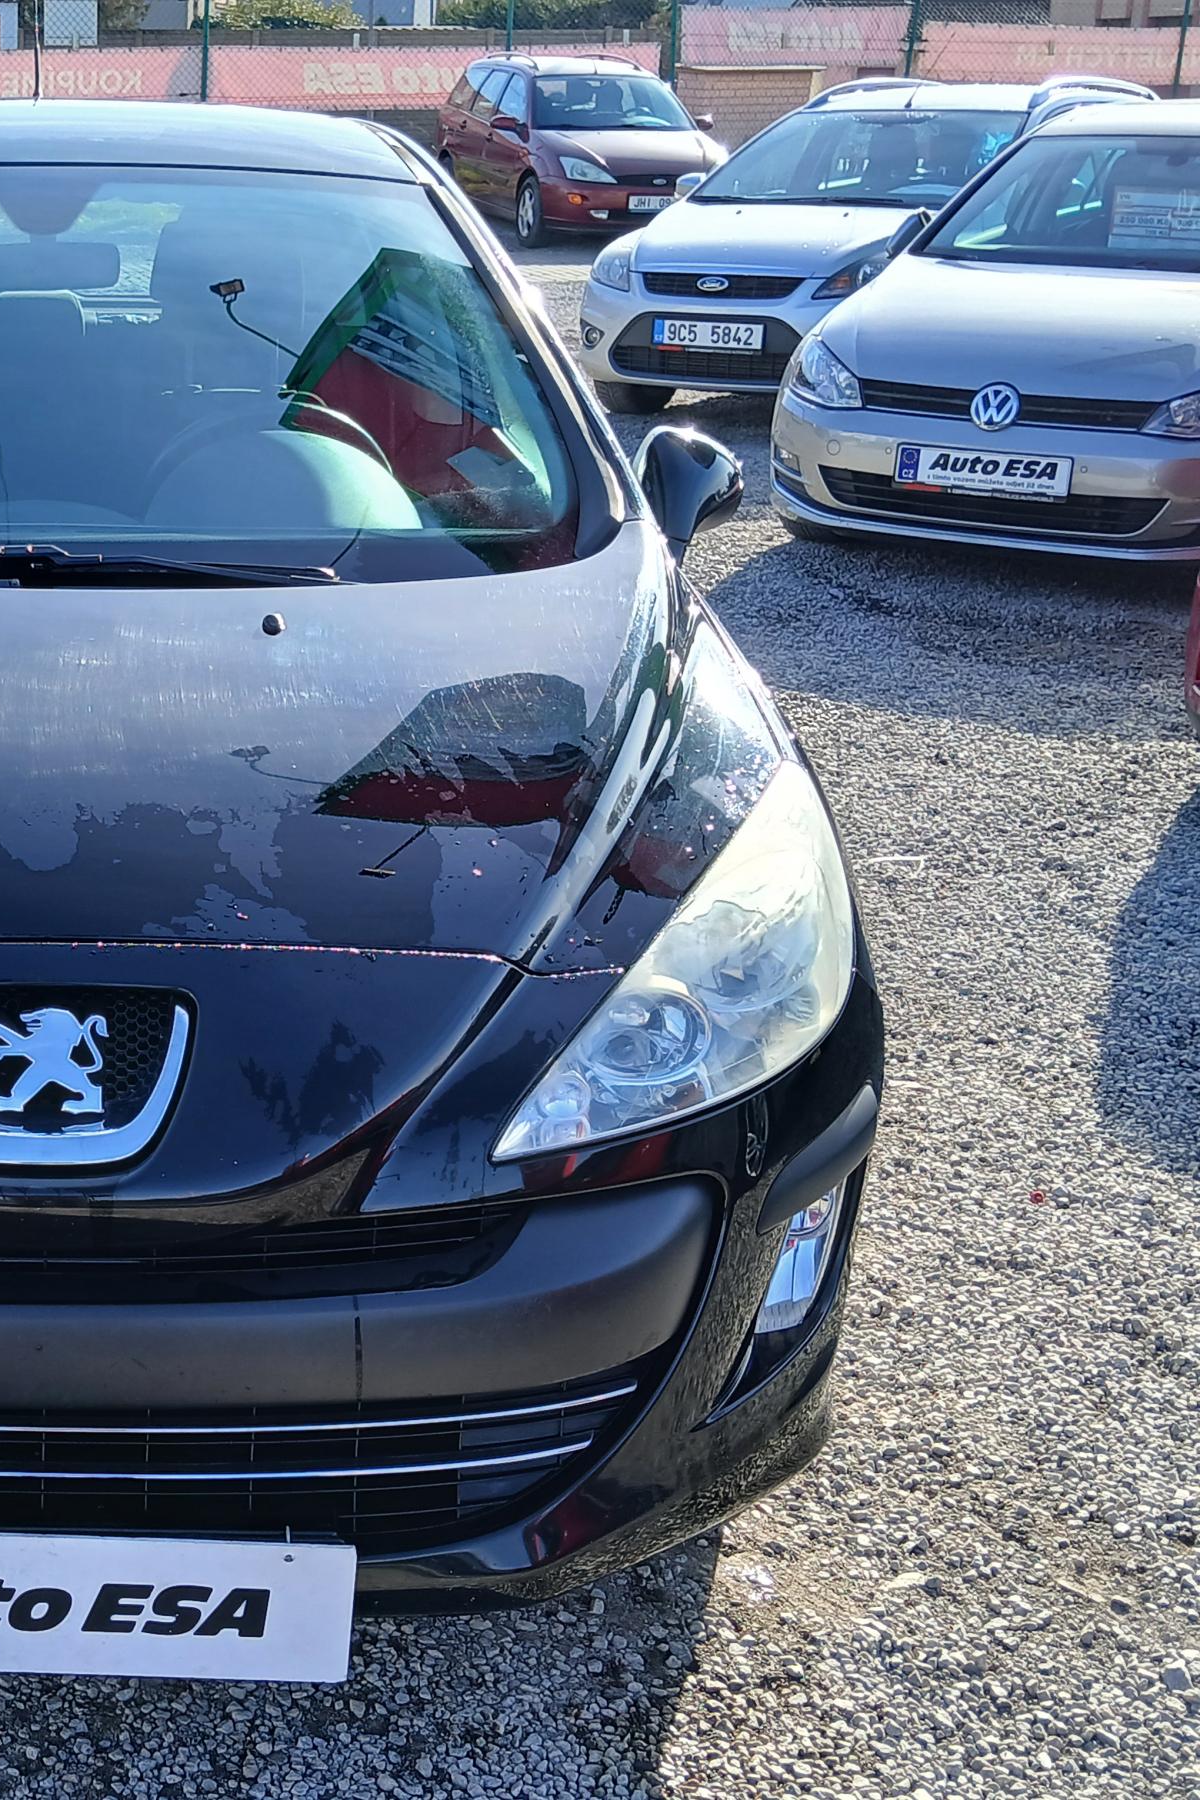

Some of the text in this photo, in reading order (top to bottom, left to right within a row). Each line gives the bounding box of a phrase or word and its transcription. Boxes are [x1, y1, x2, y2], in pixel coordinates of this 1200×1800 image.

[634, 196, 672, 208] JHI 09
[667, 323, 754, 346] 9C5 5842
[902, 469, 915, 479] CZ
[928, 453, 1059, 480] Auto ESA
[81, 1583, 271, 1638] ESA
